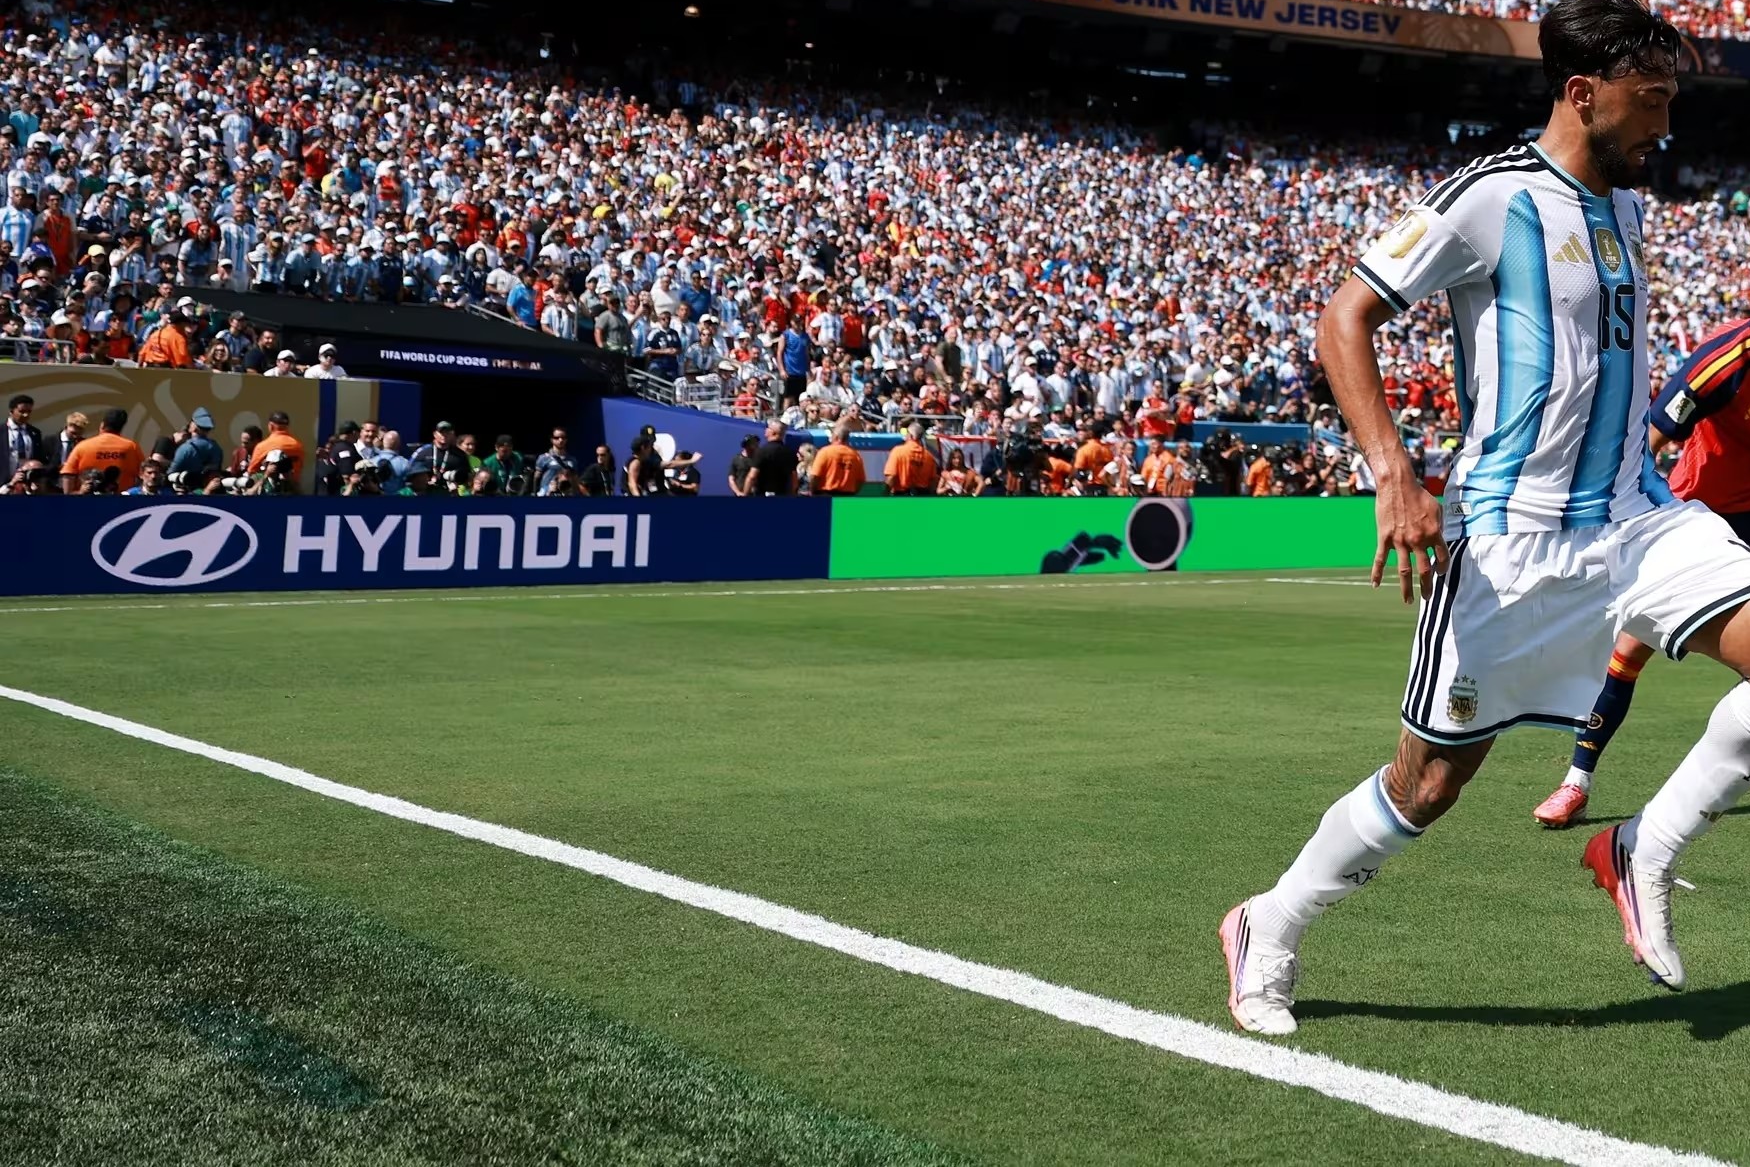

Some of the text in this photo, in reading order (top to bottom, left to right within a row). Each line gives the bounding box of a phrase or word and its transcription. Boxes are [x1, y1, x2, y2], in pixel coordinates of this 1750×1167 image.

[1274, 0, 1401, 35] JERSEY
[380, 349, 401, 360] FIFA
[402, 351, 436, 364] WORLD
[437, 354, 456, 365] CUP
[456, 355, 489, 368] 2026
[283, 513, 650, 573] HYUNDAI
